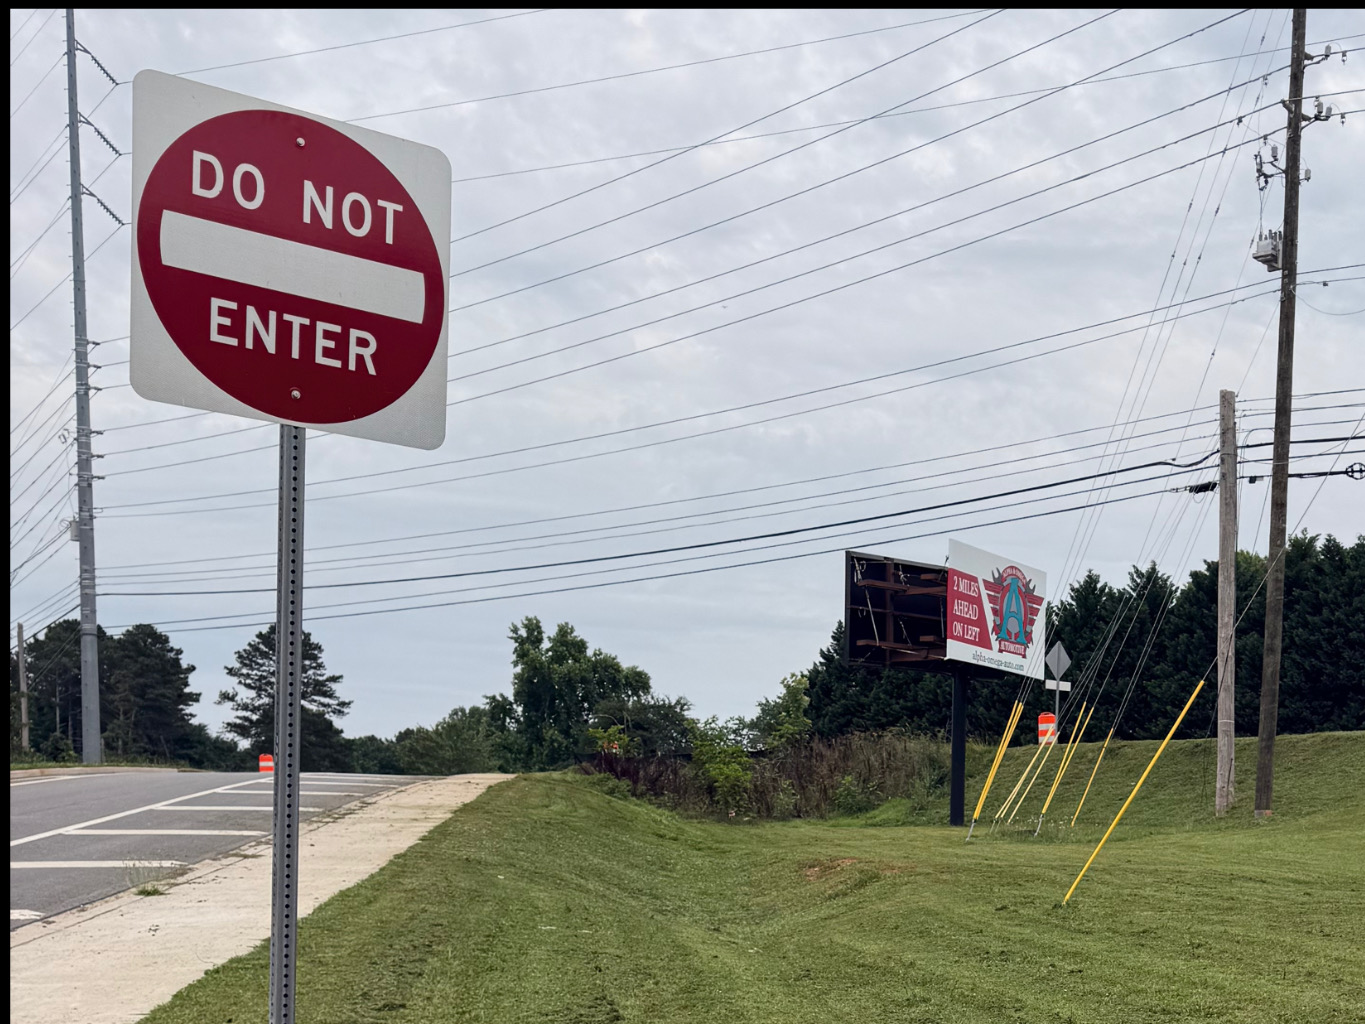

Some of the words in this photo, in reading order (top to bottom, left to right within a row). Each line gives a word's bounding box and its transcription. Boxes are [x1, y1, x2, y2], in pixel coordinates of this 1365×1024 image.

[191, 149, 265, 210] DO
[302, 179, 404, 246] NOT
[209, 296, 378, 376] ENTER
[953, 575, 958, 590] 2
[958, 577, 979, 597] MILES
[953, 598, 979, 620] AHEAD
[952, 621, 964, 638] ON
[964, 624, 980, 642] LEFT
